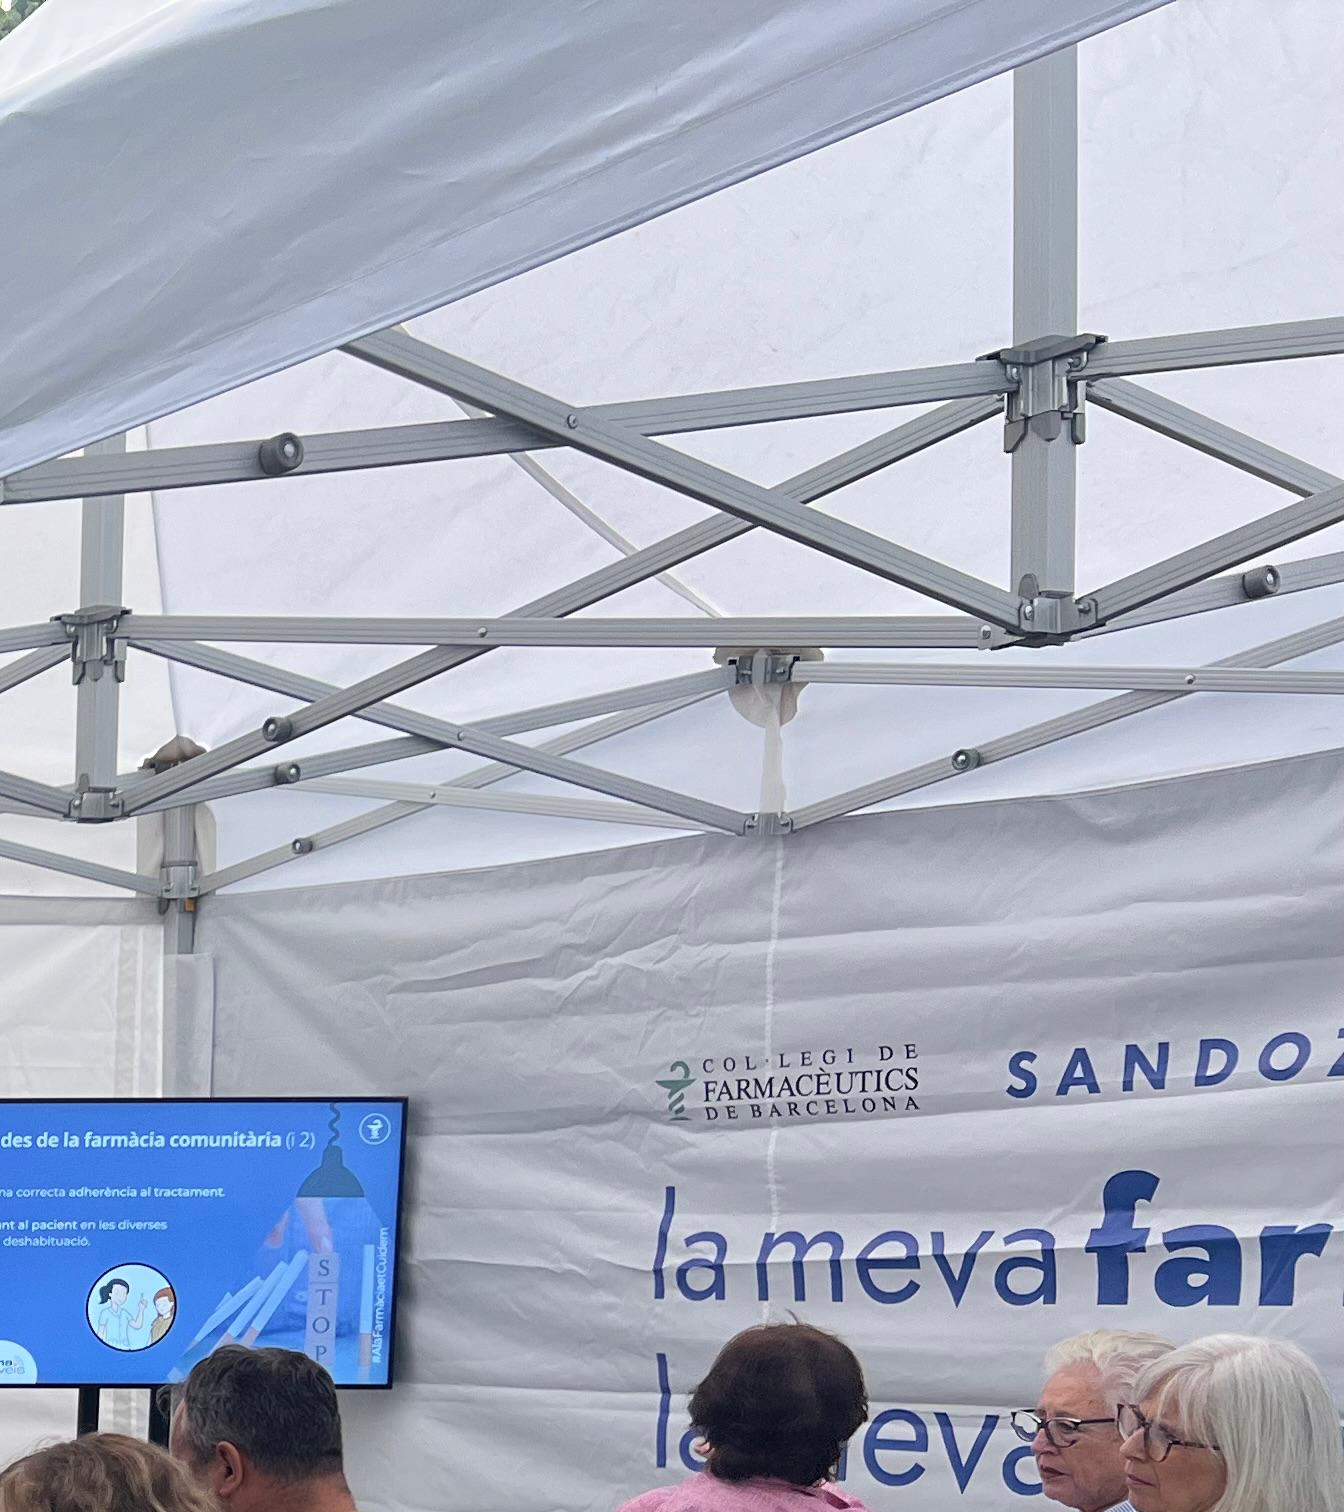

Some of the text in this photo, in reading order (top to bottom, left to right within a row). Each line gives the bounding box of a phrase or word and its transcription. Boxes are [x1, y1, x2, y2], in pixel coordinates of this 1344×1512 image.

[879, 1043, 919, 1062] DE
[703, 1067, 919, 1103] FARMACÈUTICS
[706, 1096, 921, 1121] DE BARCELONA
[0, 1131, 32, 1149] des
[36, 1131, 60, 1149] de
[63, 1131, 80, 1148] la
[84, 1131, 165, 1149] farmàcia
[169, 1131, 282, 1149] comunitària
[16, 1188, 65, 1199] correcta
[68, 1187, 137, 1199] adherència
[140, 1187, 151, 1198] al
[18, 1220, 29, 1231] al
[31, 1220, 78, 1233] pacient
[80, 1222, 96, 1231] en
[99, 1220, 116, 1231] les
[118, 1220, 168, 1231] diverses
[653, 1169, 1344, 1309] la meva far
